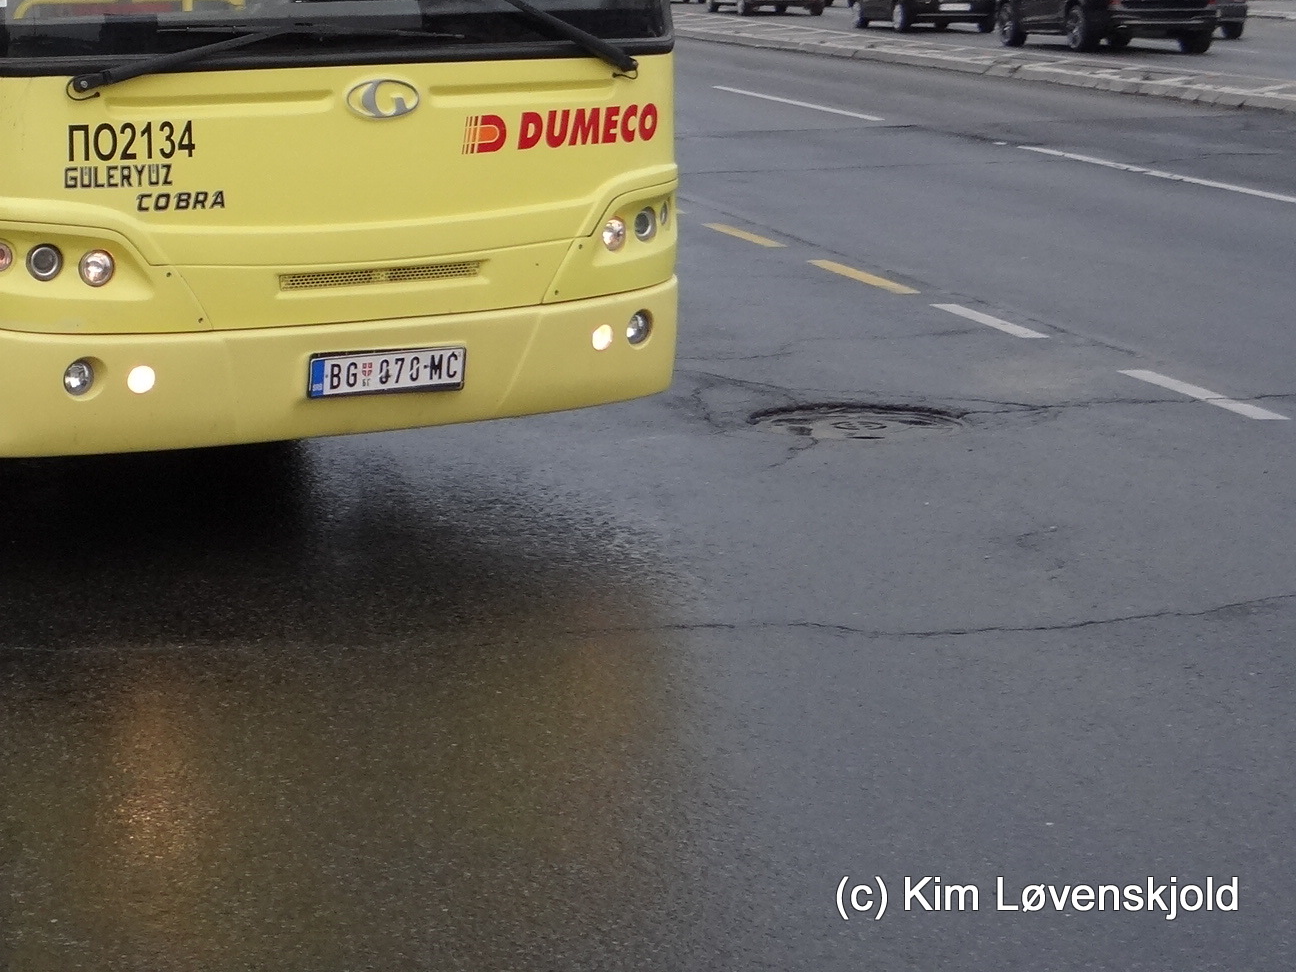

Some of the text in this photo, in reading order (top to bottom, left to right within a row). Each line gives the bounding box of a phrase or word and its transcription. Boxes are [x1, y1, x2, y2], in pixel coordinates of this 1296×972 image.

[517, 102, 658, 151] DUMECO
[64, 163, 173, 189] GÜLERYÜZ
[136, 190, 226, 213] COBRA
[330, 362, 358, 390] BG
